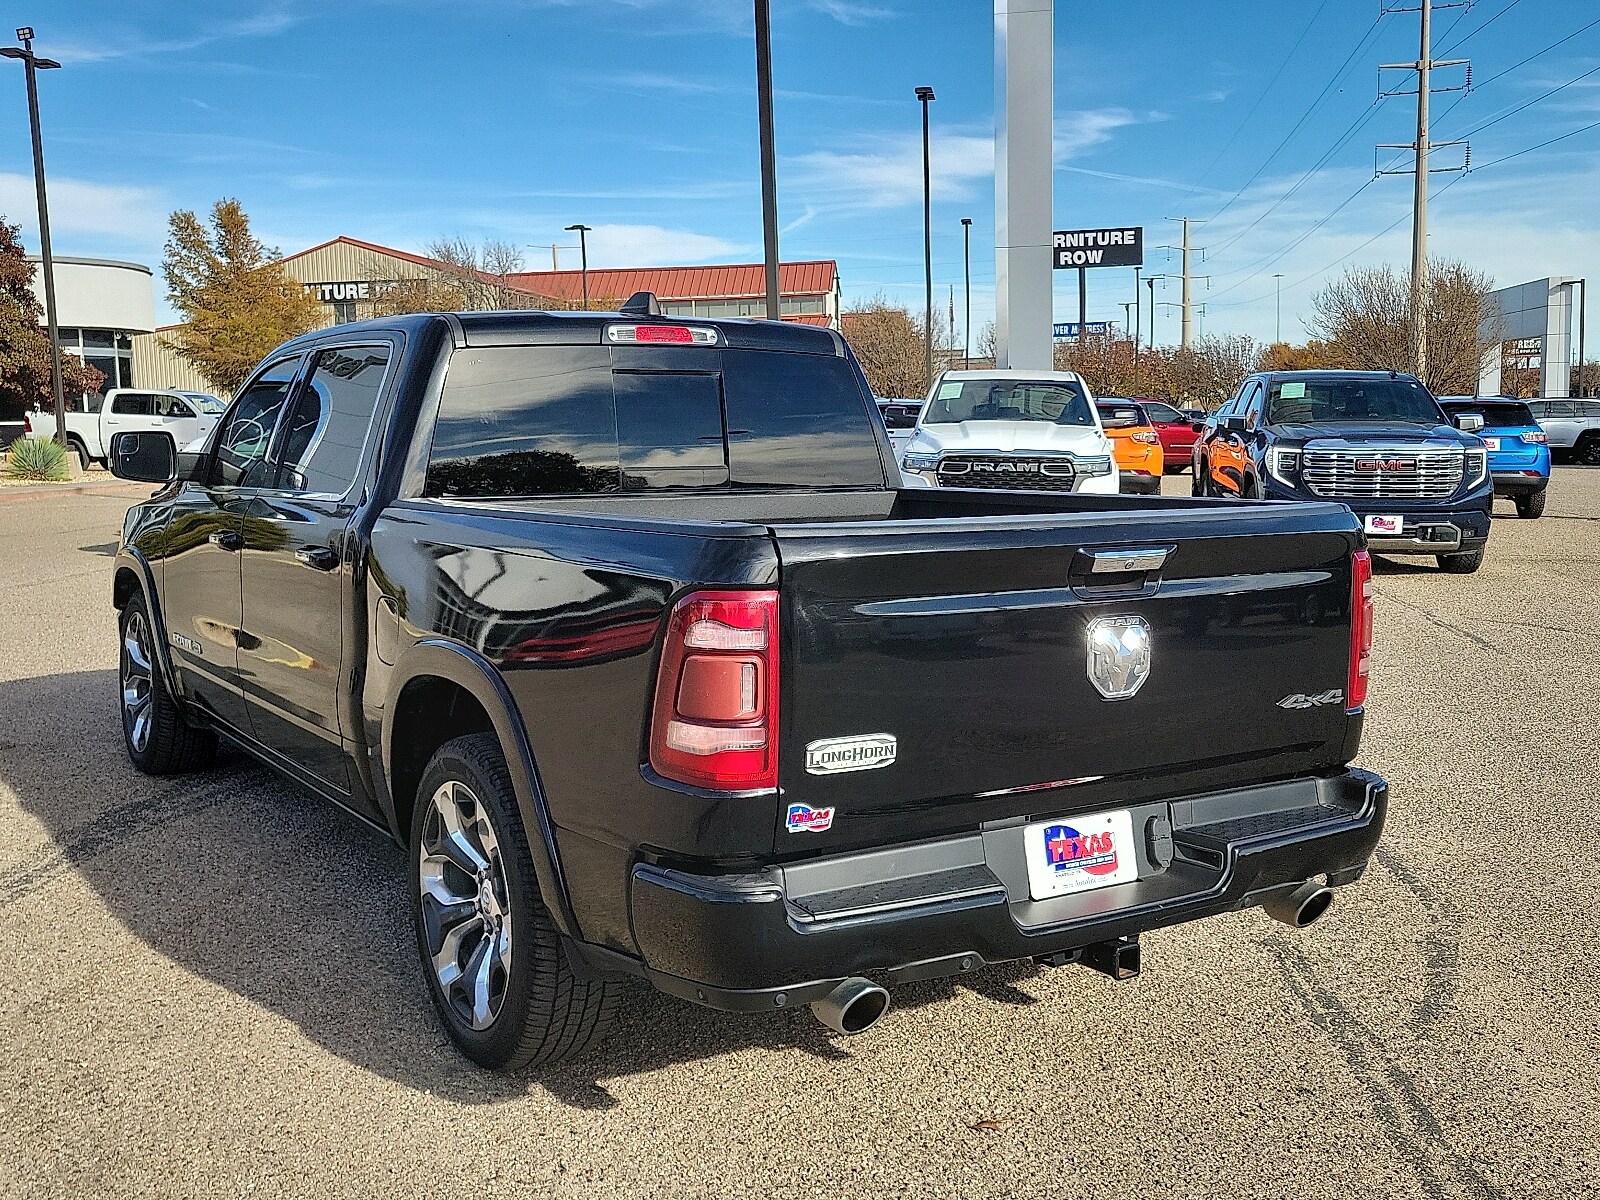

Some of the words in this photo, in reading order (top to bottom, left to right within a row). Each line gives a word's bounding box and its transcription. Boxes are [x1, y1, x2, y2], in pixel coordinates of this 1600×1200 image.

[1059, 250, 1103, 265] ROW
[1071, 324, 1105, 335] MTRESS
[973, 462, 1038, 472] RAM
[1357, 459, 1415, 471] GMC
[791, 809, 831, 823] TEXAS
[1048, 831, 1113, 862] TEXAS
